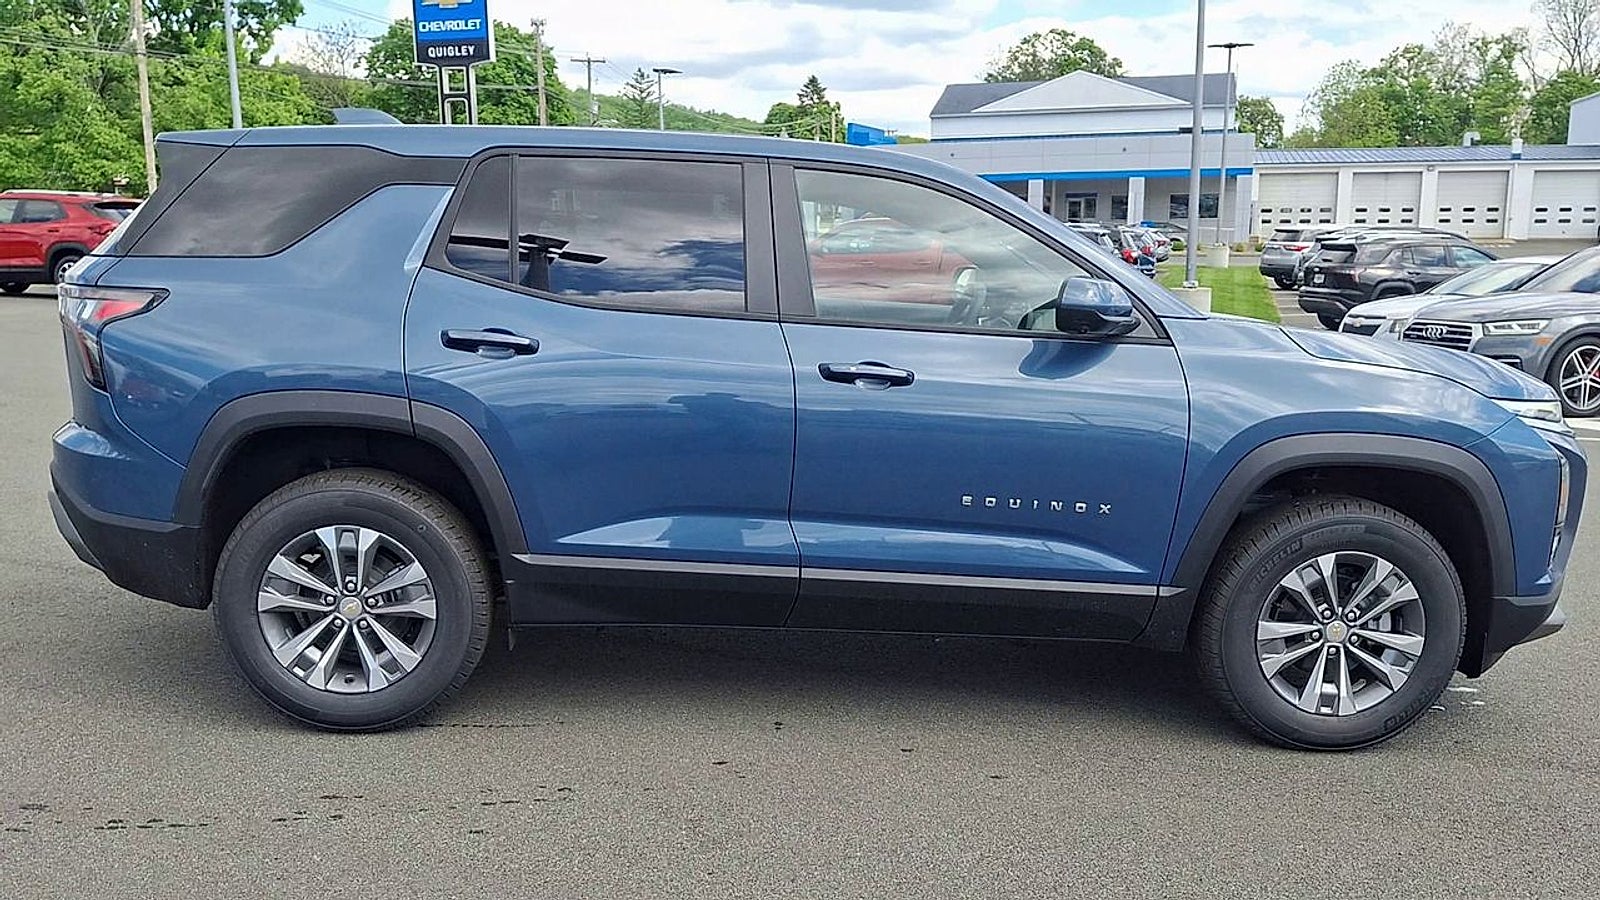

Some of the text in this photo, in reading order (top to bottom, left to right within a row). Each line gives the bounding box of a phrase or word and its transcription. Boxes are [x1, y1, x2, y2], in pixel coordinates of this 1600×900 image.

[418, 19, 481, 32] CHEVROLET
[427, 45, 475, 58] QUIGLEY
[961, 495, 1111, 514] EQUINOX
